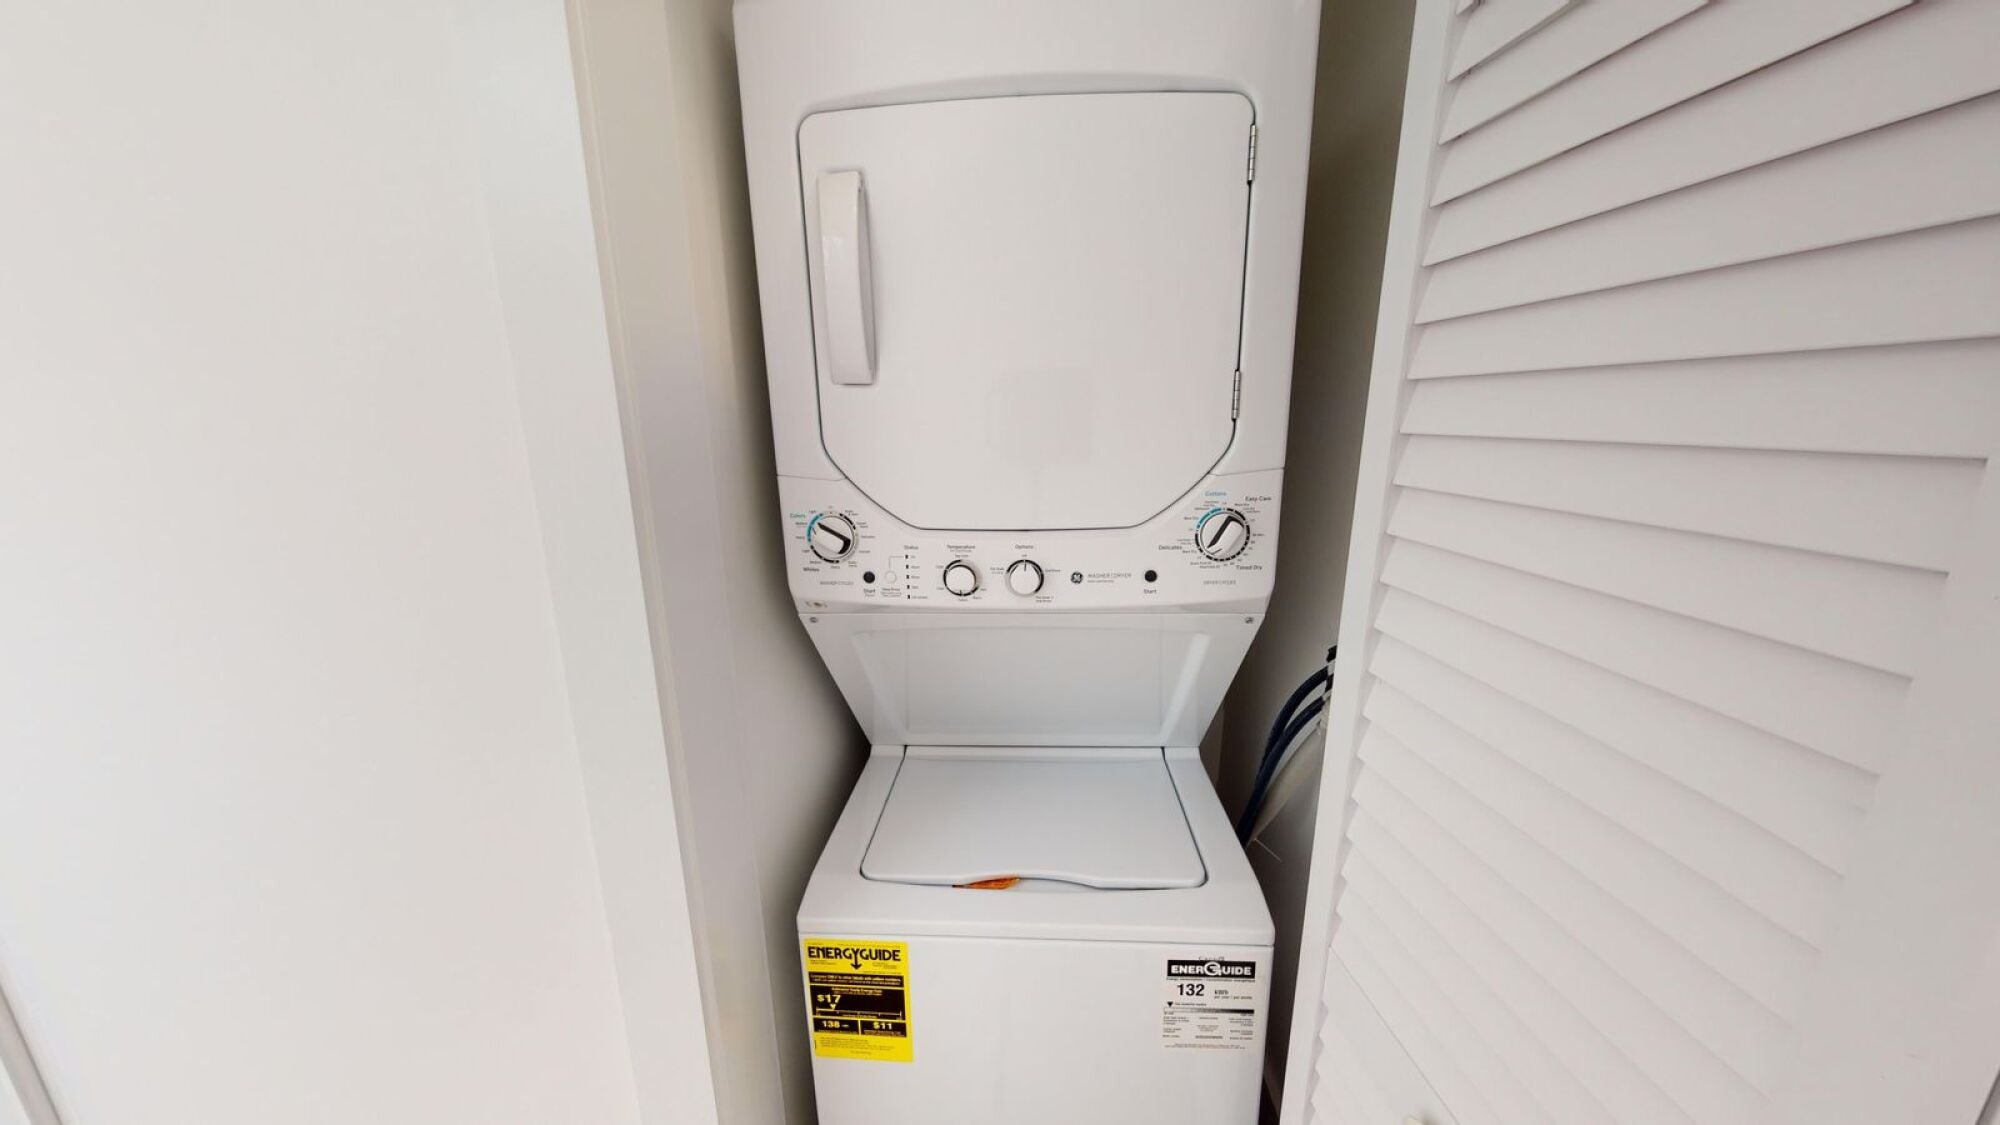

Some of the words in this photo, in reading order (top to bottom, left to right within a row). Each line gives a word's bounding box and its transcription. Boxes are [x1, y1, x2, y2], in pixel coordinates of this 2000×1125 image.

[807, 946, 901, 962] ENERGYGUIDE
[1177, 983, 1205, 997] 132
[816, 994, 841, 1004] $17
[822, 1020, 841, 1029] 138
[872, 1022, 893, 1030] $11
